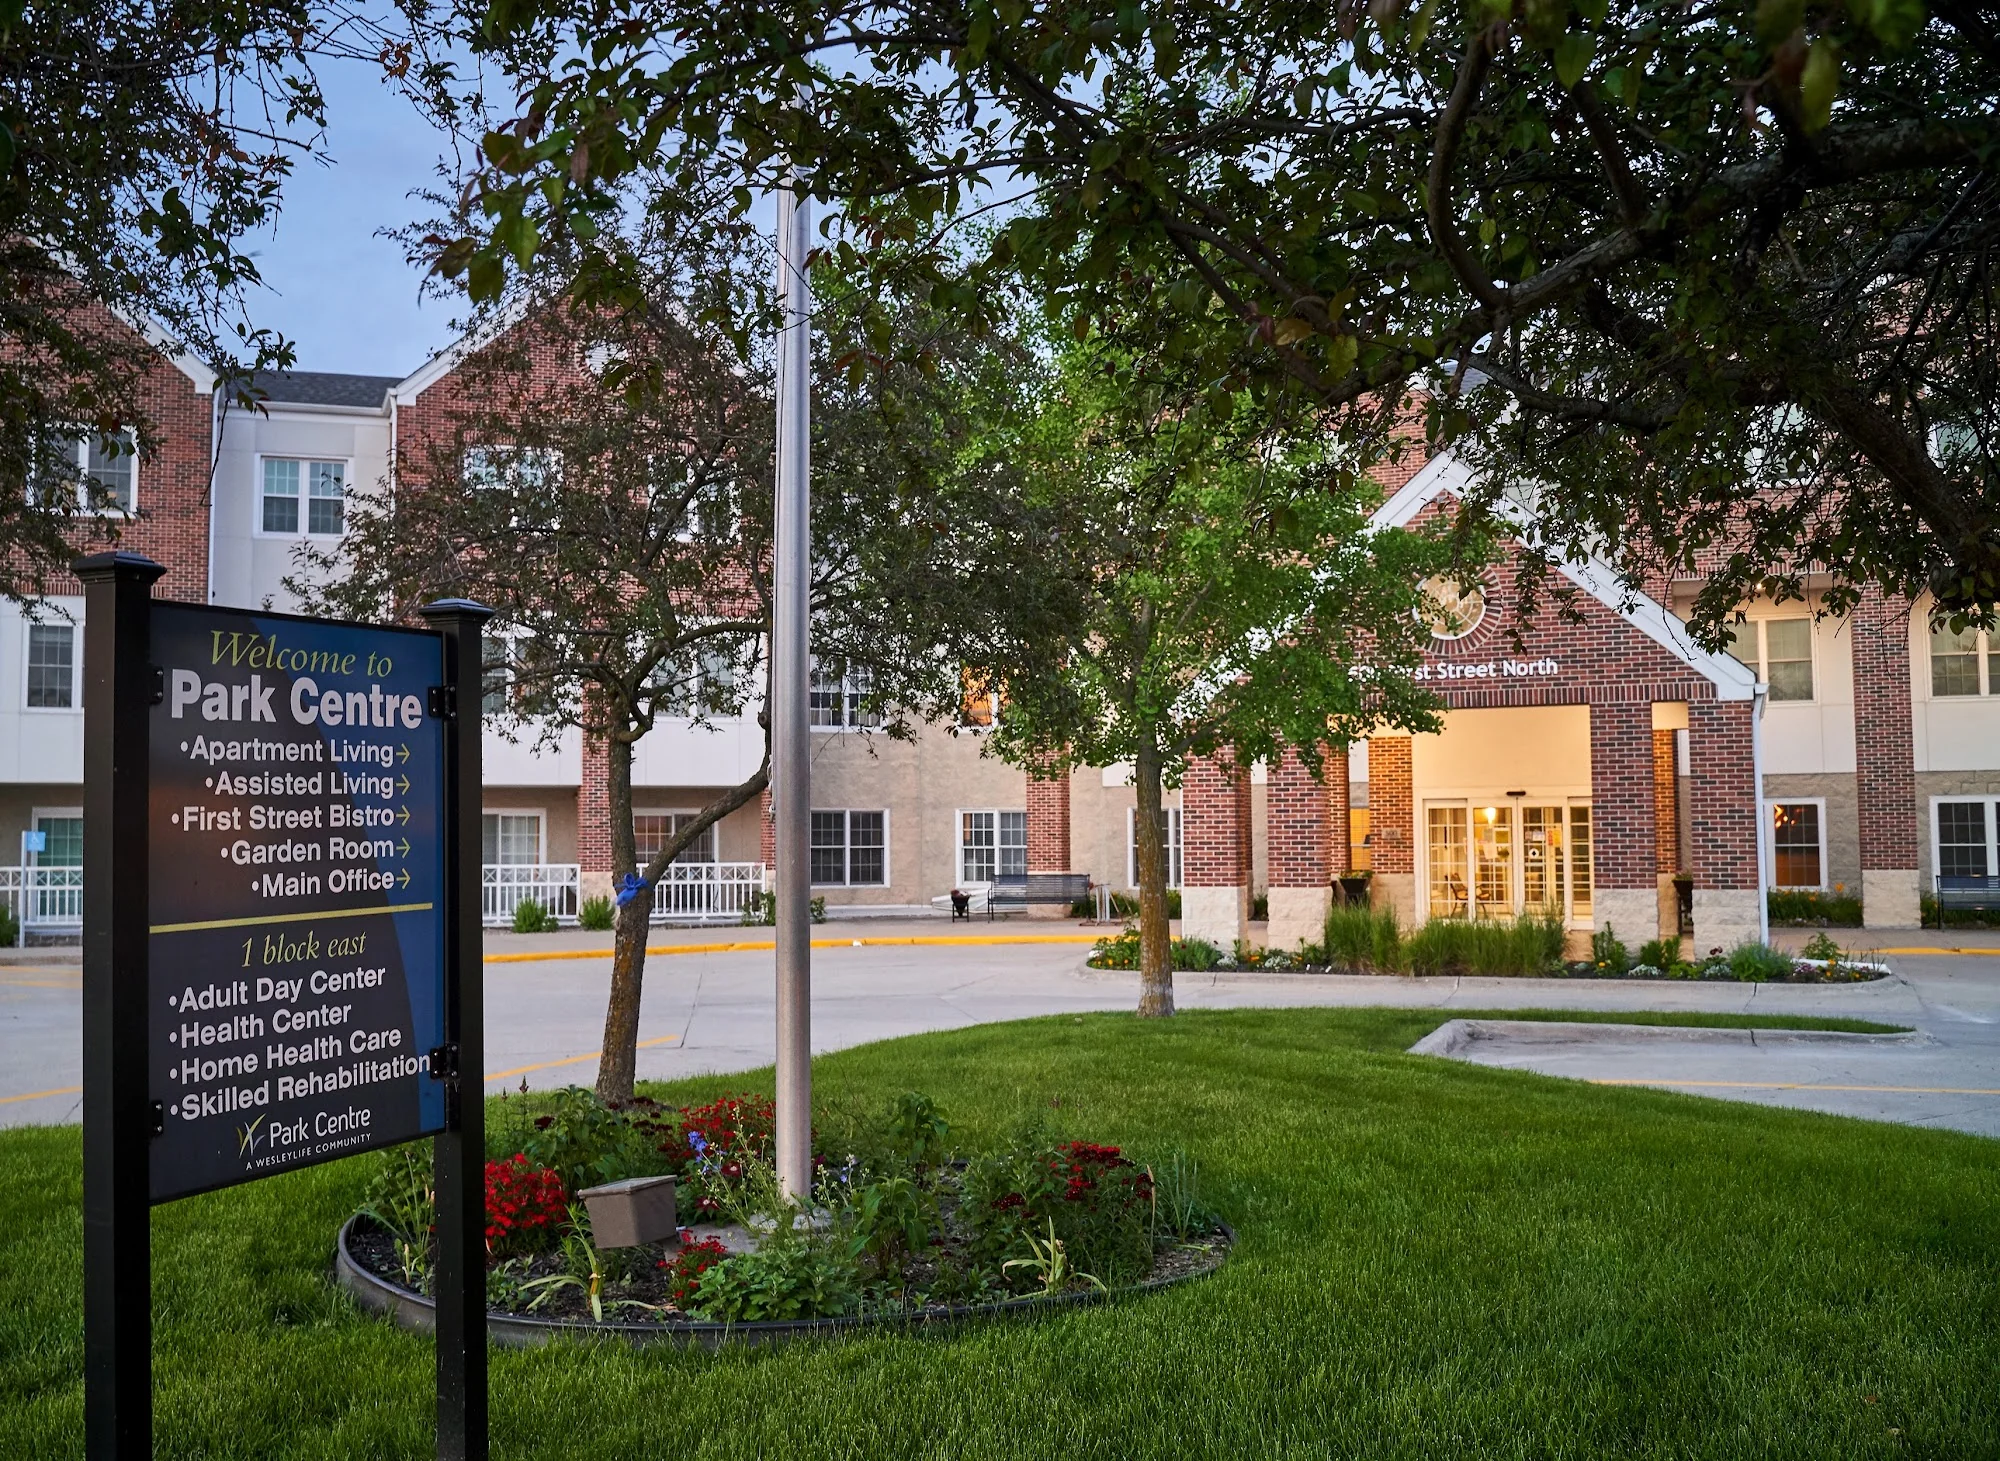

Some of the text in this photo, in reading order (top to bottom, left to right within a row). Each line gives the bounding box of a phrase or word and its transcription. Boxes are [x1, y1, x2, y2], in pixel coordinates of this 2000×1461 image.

[210, 630, 393, 678] Welcome to
[1437, 662, 1497, 680] Street
[1503, 657, 1559, 677] North
[171, 669, 423, 729] Park Centre
[190, 735, 394, 768] Apartment Living
[214, 771, 394, 799] Assisted Living
[183, 804, 394, 831] First Street Bistro
[231, 837, 394, 865] Garden Room
[262, 869, 394, 897] Main Office
[241, 930, 366, 967] 1 block east
[179, 967, 386, 1012] Adult Day Center
[181, 1003, 351, 1048] Health Center
[181, 1028, 402, 1085] Home Health Care
[181, 1054, 431, 1120] Skilled Rehabilitation
[270, 1106, 370, 1148] Park Centre
[246, 1133, 371, 1171] A WESLEYLIFE COMMUNITY
